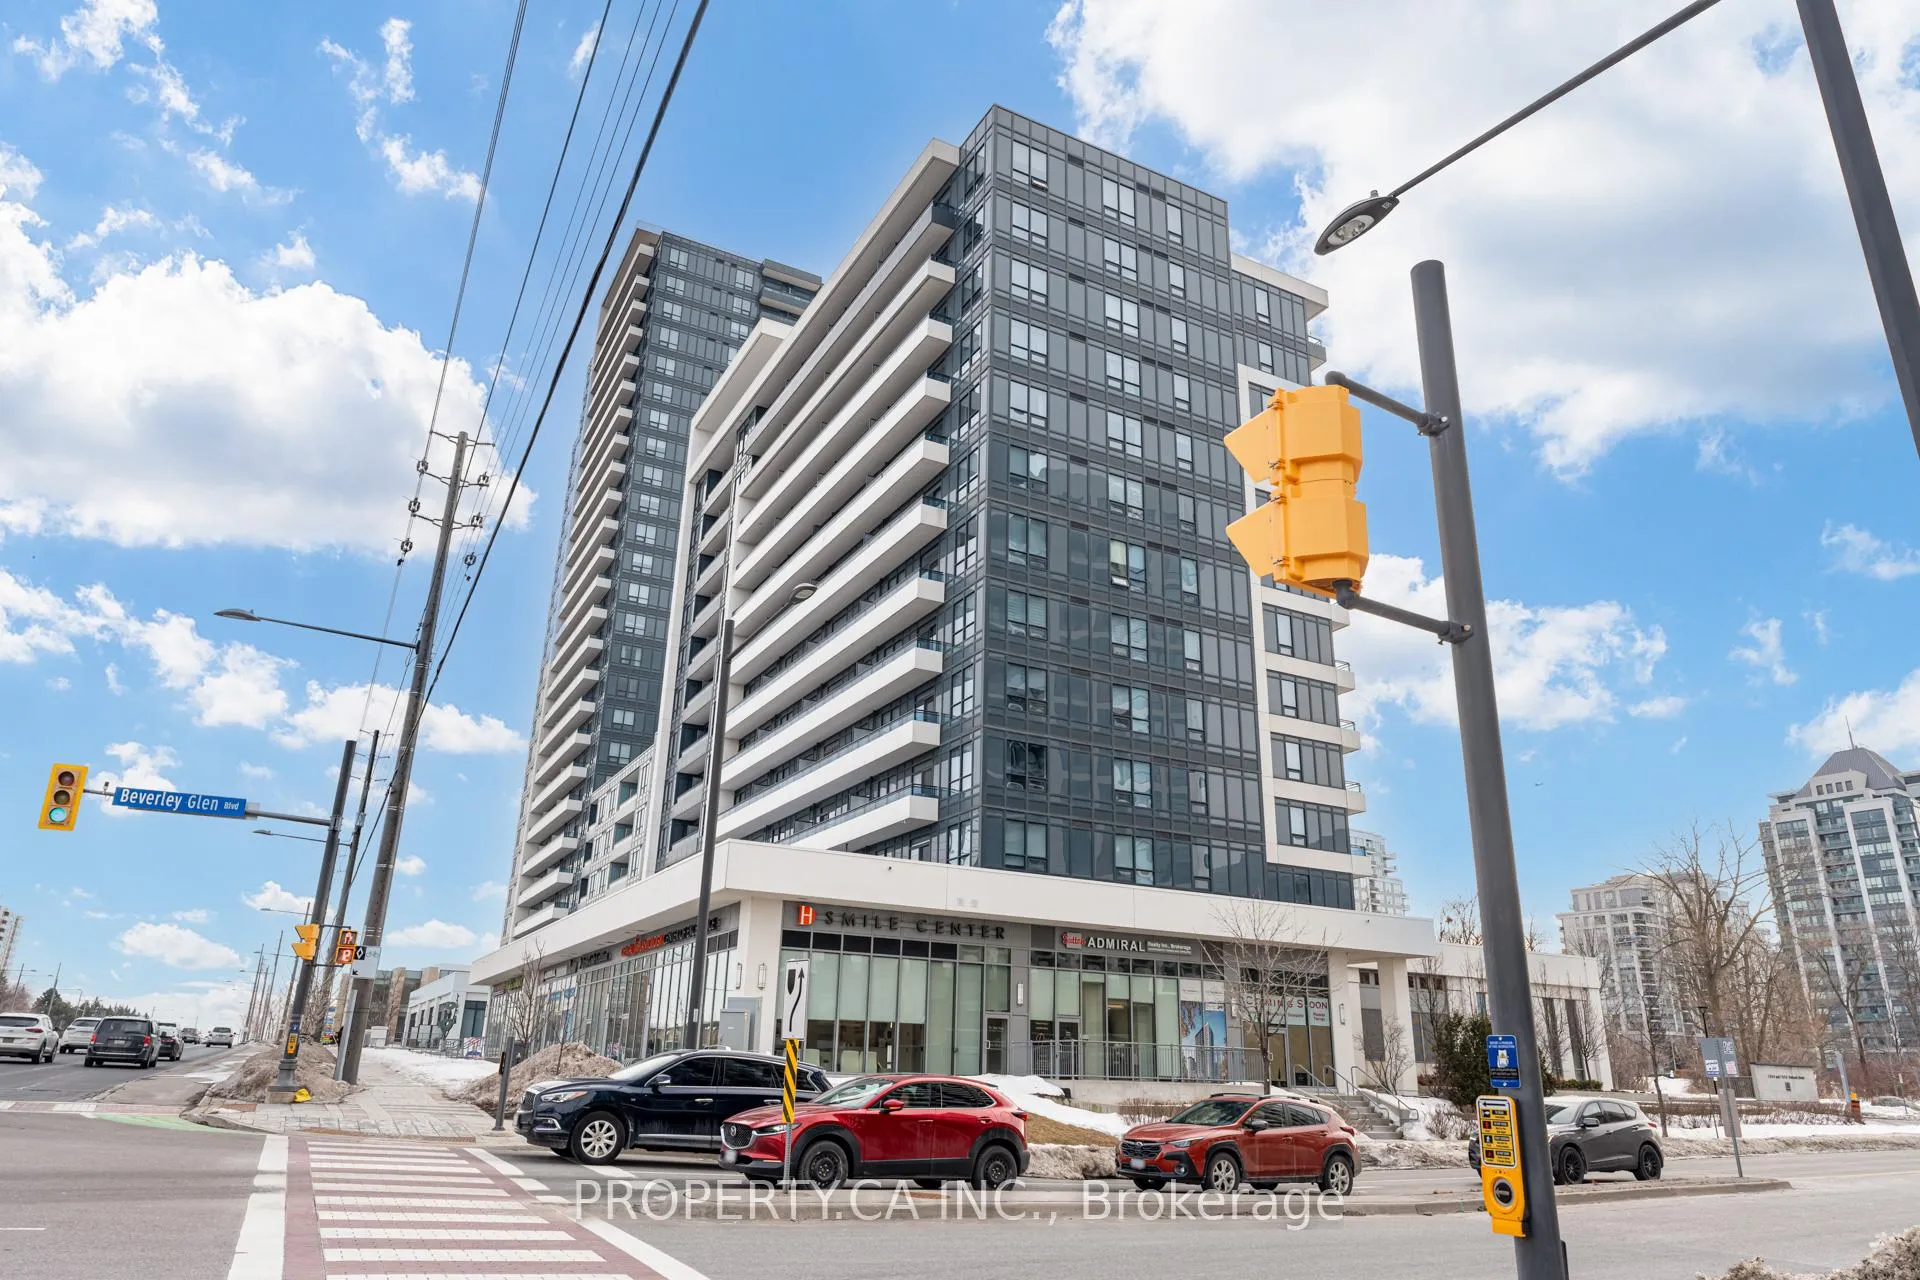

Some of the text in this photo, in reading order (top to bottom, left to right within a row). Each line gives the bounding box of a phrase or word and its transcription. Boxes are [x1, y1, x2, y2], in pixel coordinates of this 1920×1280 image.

[120, 788, 240, 811] Beverley Glen Blvd
[824, 910, 1005, 940] SMILE CENTER
[1087, 936, 1146, 952] ADMIRAL
[1245, 995, 1328, 1009] CMING SOON
